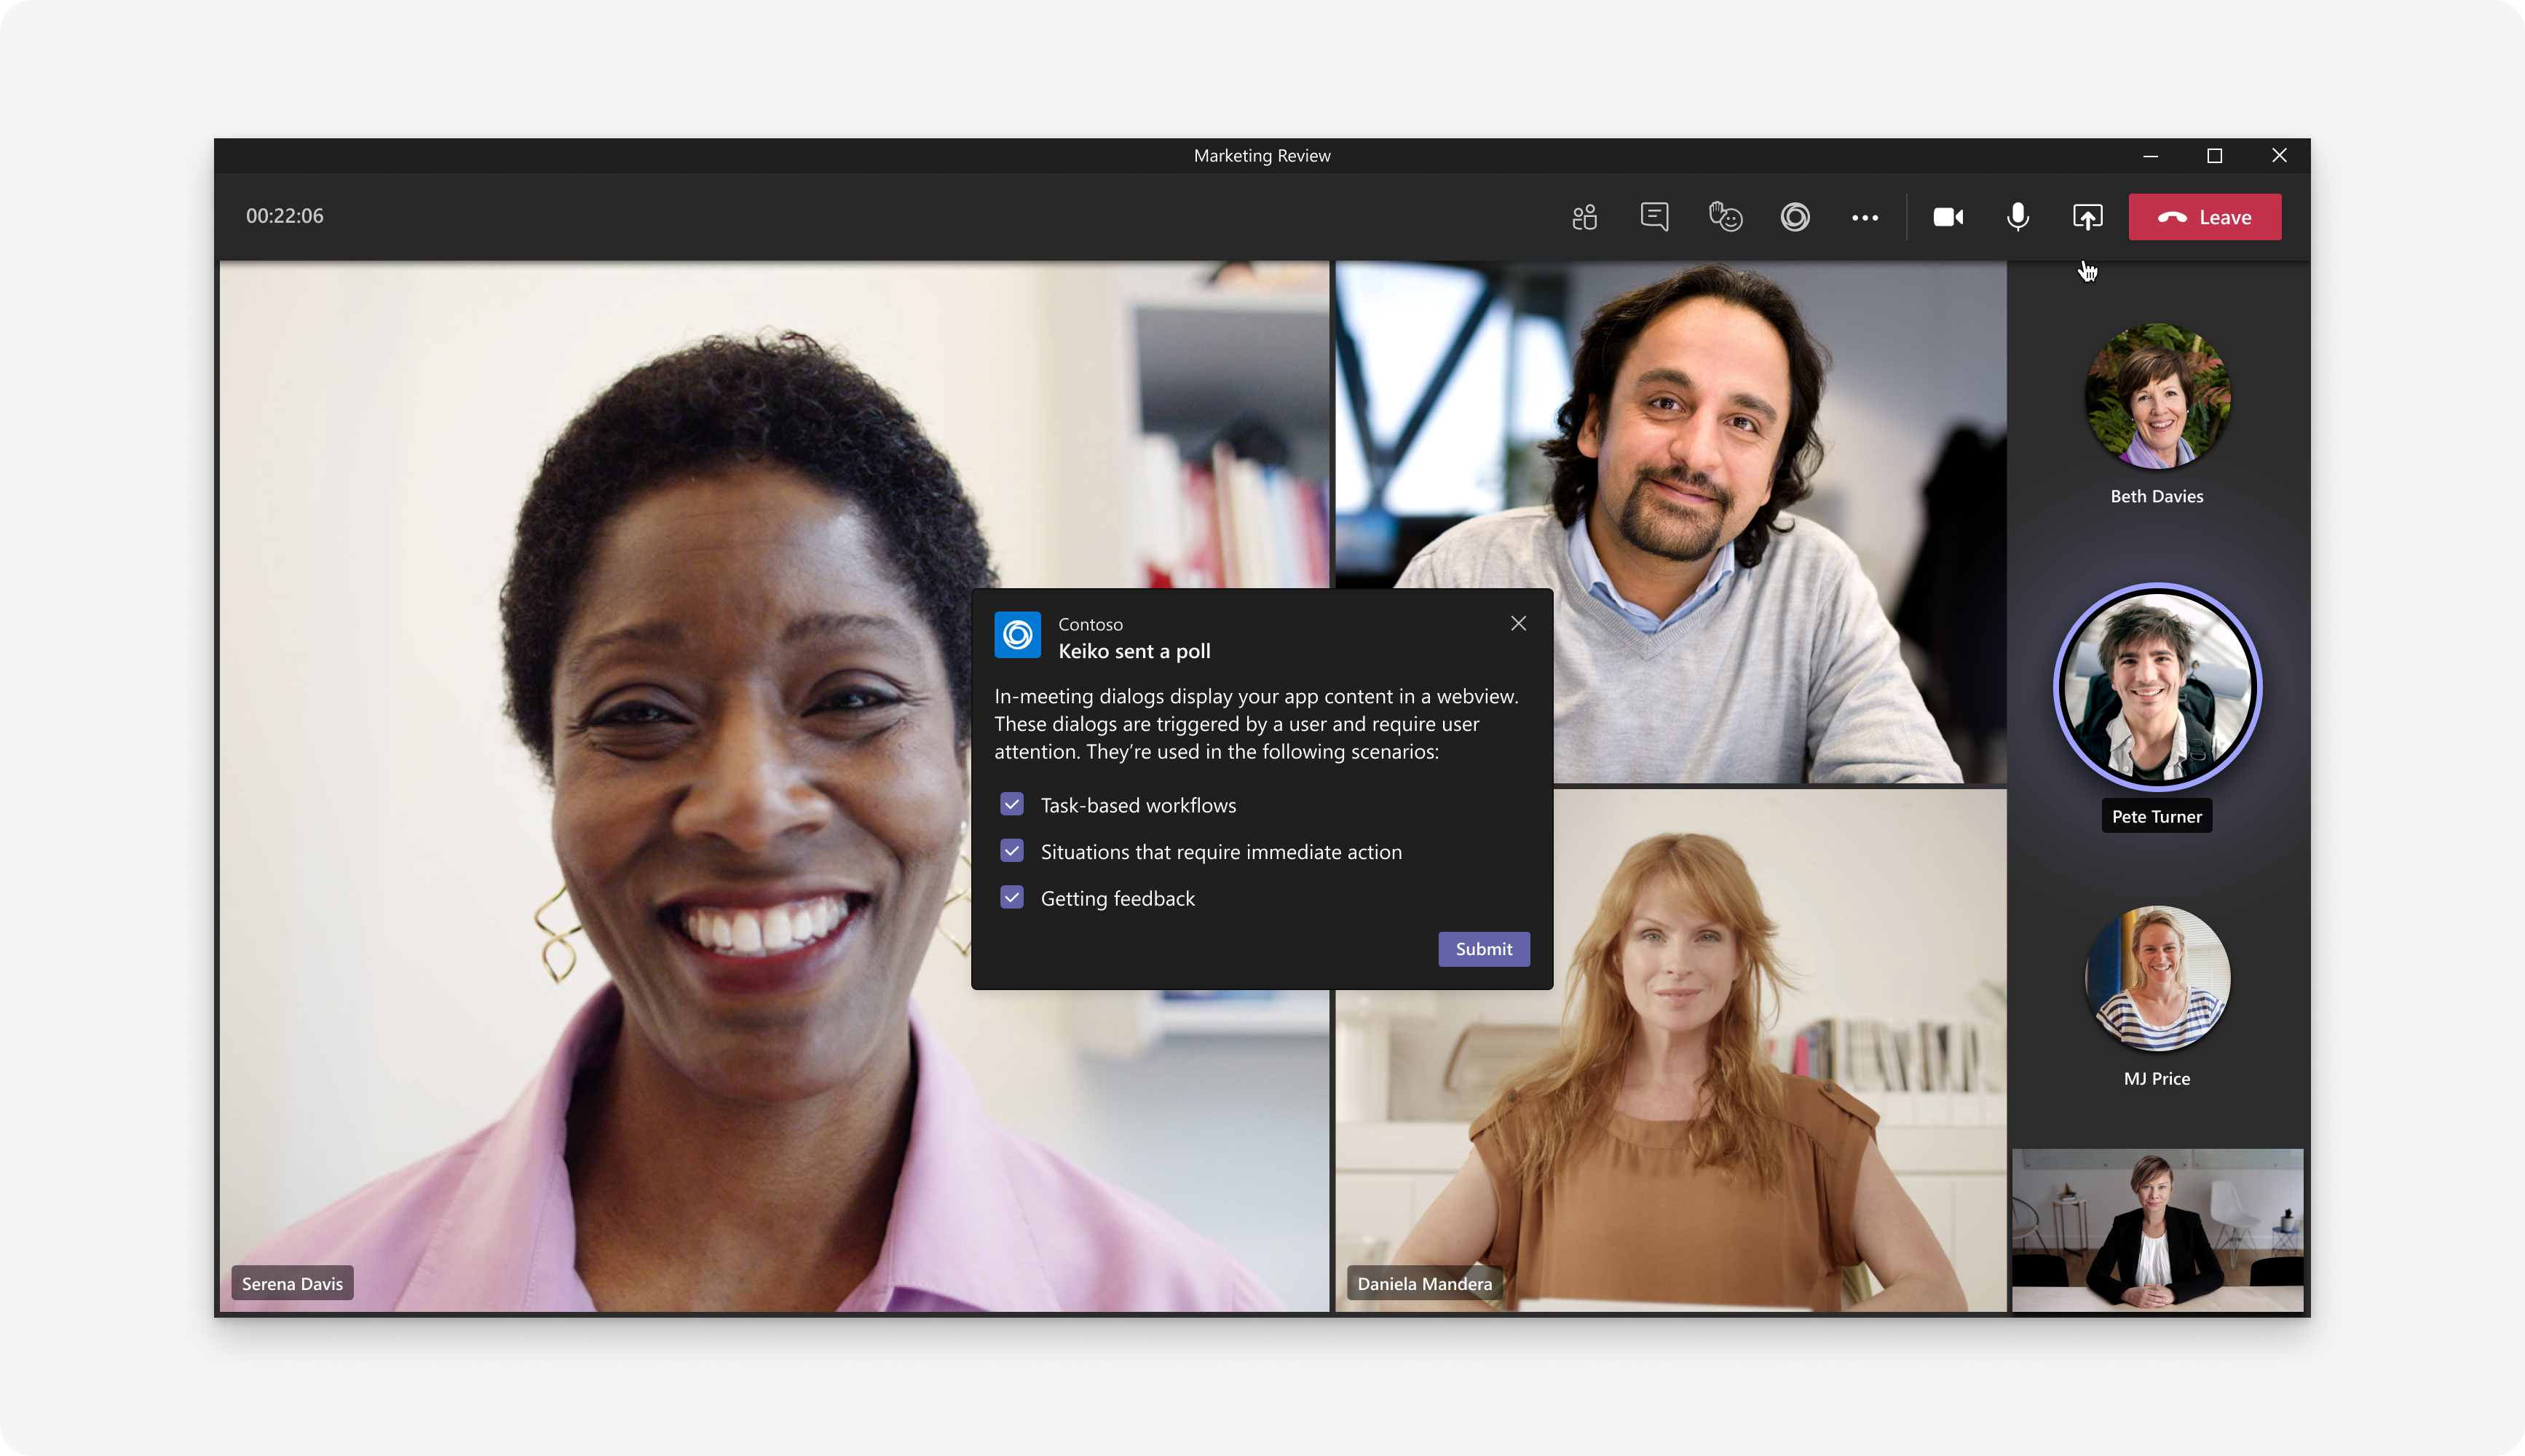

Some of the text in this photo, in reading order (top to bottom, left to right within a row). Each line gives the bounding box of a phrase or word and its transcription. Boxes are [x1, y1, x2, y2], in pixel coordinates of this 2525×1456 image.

[1195, 148, 1332, 167] Marketing Review
[246, 207, 324, 223] 00:22:06
[2200, 209, 2252, 225] Leave
[2111, 488, 2204, 503] Beth Davies
[1059, 617, 1123, 631] Contoso
[1059, 642, 1211, 664] Keiko sent a poll
[995, 687, 1519, 709] In-meeting dialogs display your app content in a webview.
[994, 715, 1480, 737] These dialogs are triggered by a user and require user
[995, 743, 1439, 764] attention. They’re used in the following scenarios:
[1040, 796, 1237, 814] Task-based workflows
[2113, 810, 2203, 823] Pete Turner
[1041, 843, 1402, 865] Situations that require immediate action
[1041, 890, 1196, 911] Getting feedback
[1456, 941, 1513, 956] Submit
[2125, 1071, 2191, 1085] MJ Price
[242, 1276, 344, 1291] Serena Davis
[1359, 1276, 1493, 1291] Daniela Mandera
